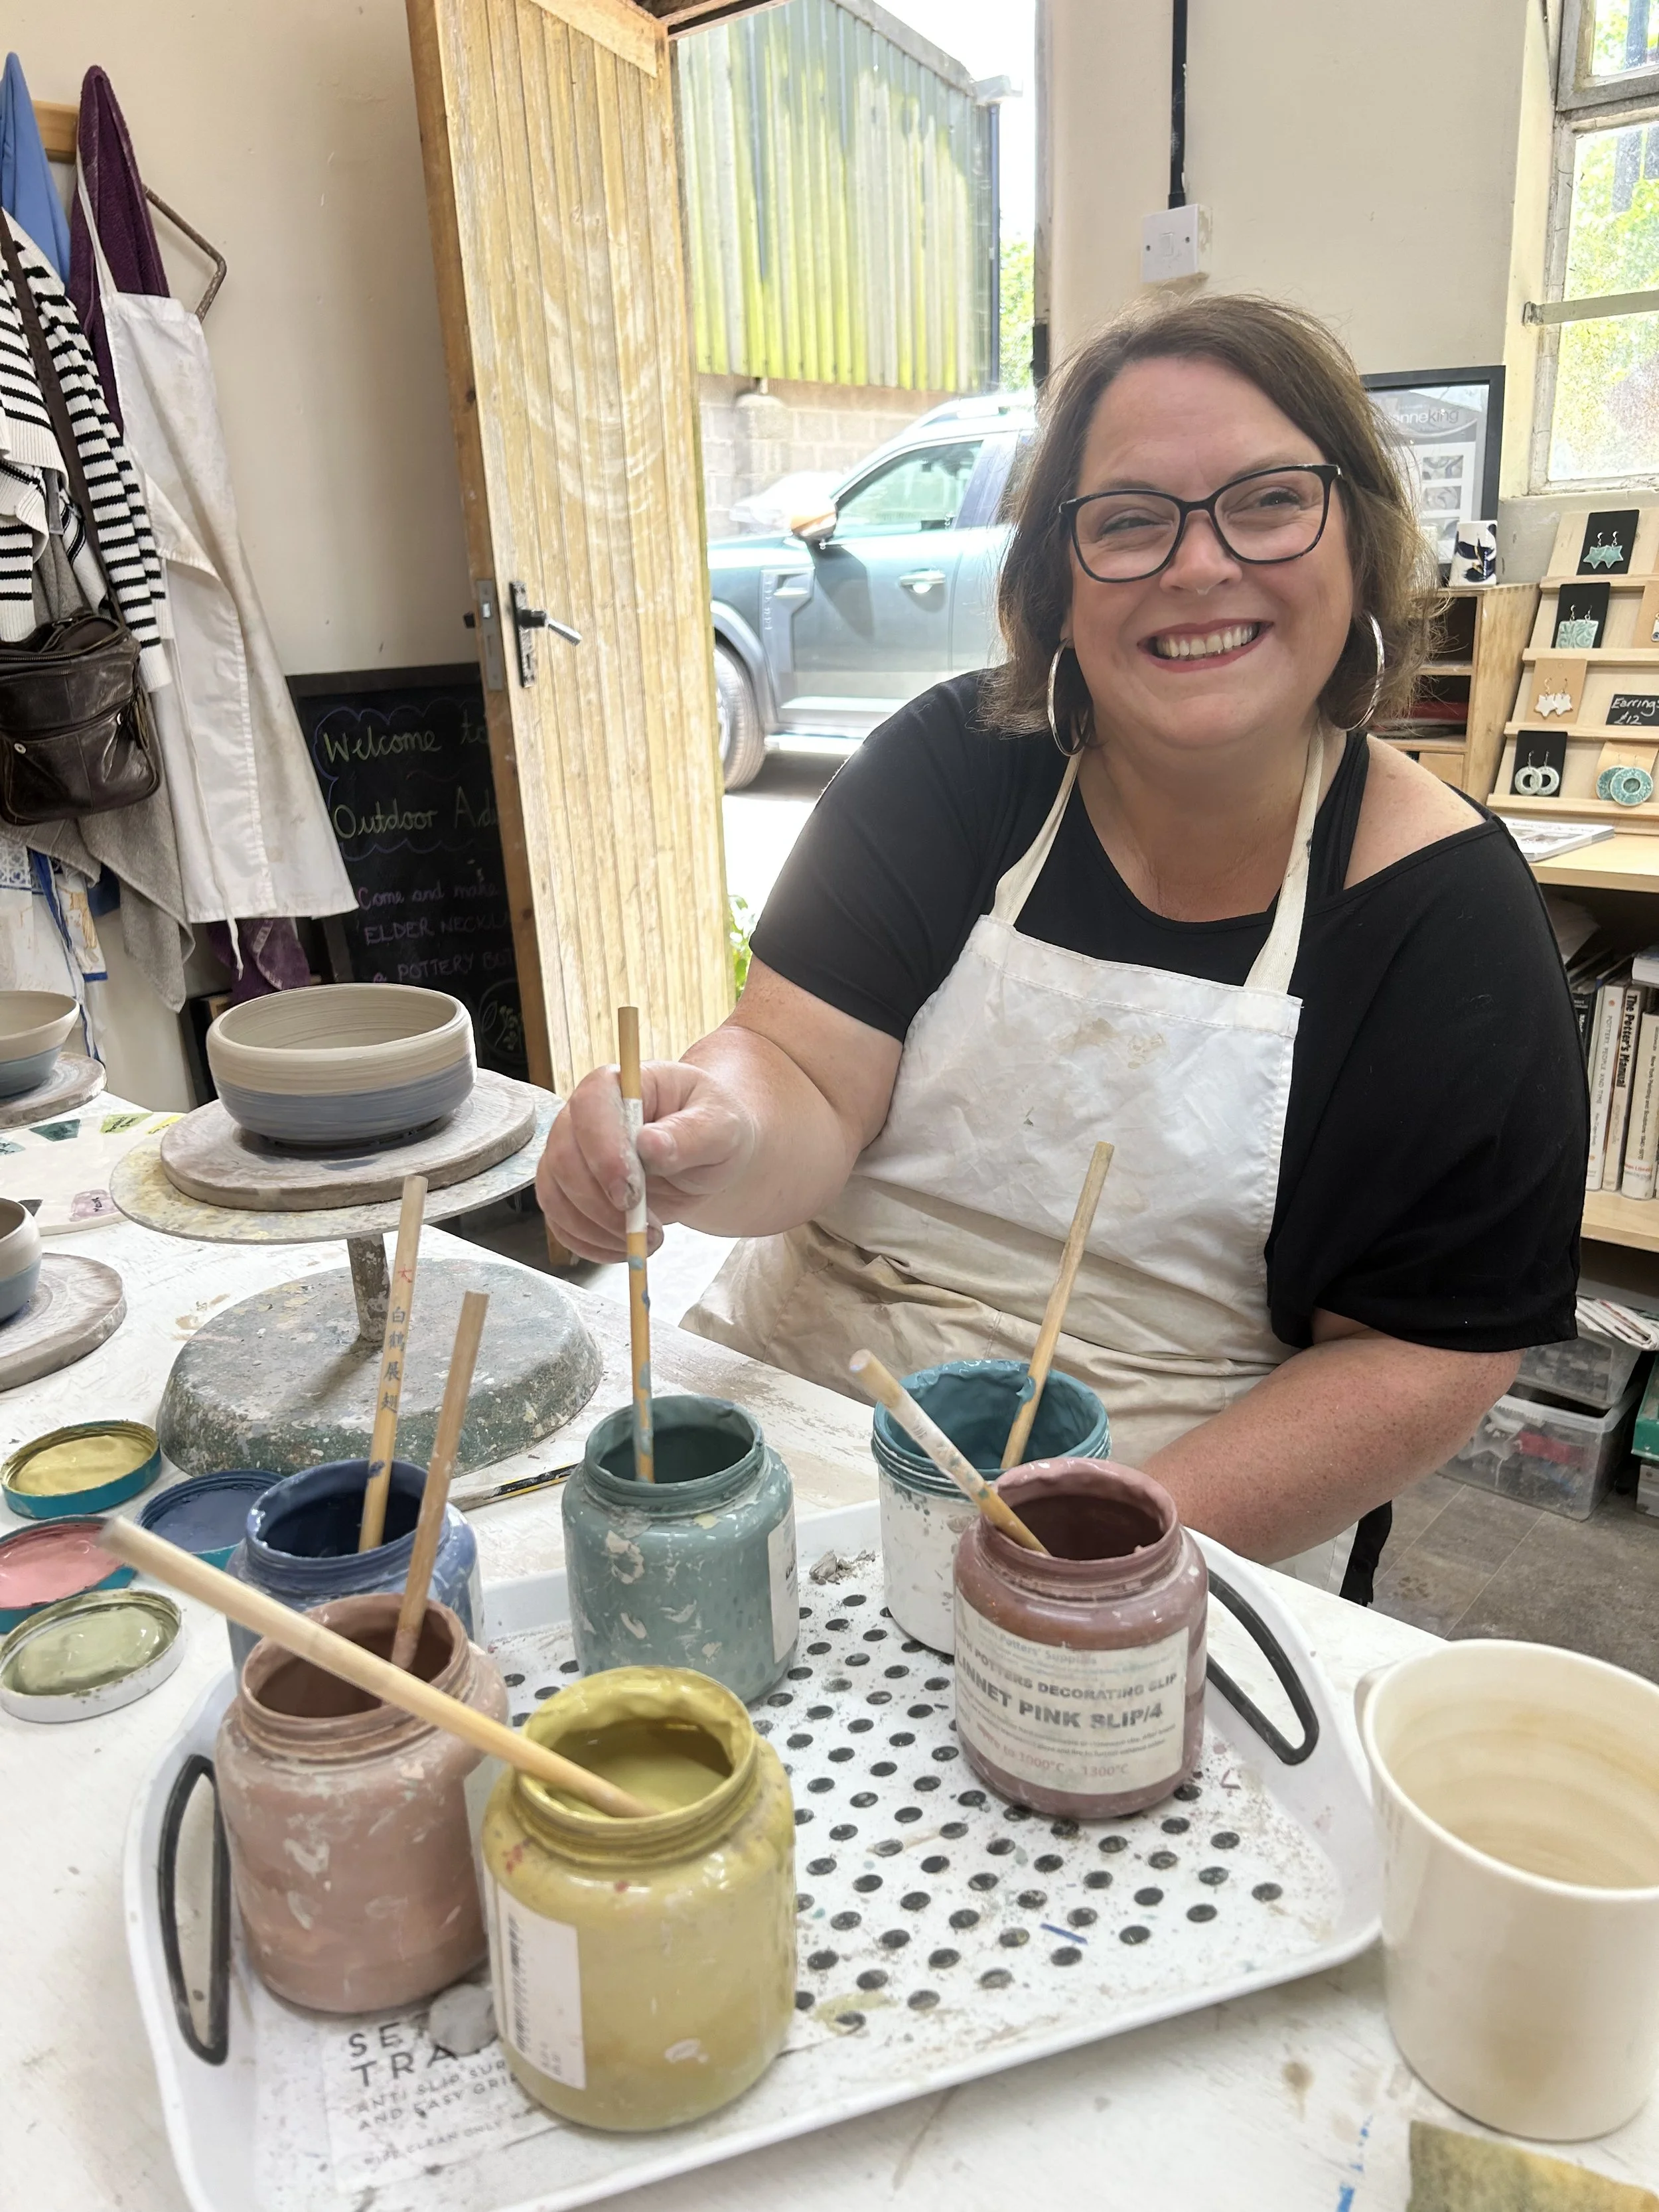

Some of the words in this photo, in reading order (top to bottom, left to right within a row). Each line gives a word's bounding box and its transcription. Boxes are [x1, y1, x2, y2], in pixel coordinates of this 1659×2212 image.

[1614, 711, 1642, 725] £12
[323, 725, 442, 763] Welcome
[334, 798, 438, 839] Outdoor
[455, 786, 497, 829] Ad
[358, 887, 404, 910] Come
[411, 879, 445, 902] and
[365, 917, 434, 945] ELDER
[397, 953, 474, 982] POTTERY
[1626, 995, 1637, 1011] The
[1621, 1013, 1635, 1053] Potter's
[1616, 1053, 1630, 1088] Manual
[957, 1648, 1012, 1708] LINNET
[1019, 1699, 1082, 1728] PINK
[1090, 1702, 1163, 1730] SLIP/4
[974, 1648, 1033, 1689] POTTERS
[1037, 1680, 1145, 1701] DECORATING
[1147, 1672, 1177, 1692] SLIP
[350, 2043, 461, 2087] TRA
[469, 2059, 506, 2078] SUR
[358, 2108, 403, 2132] AND
